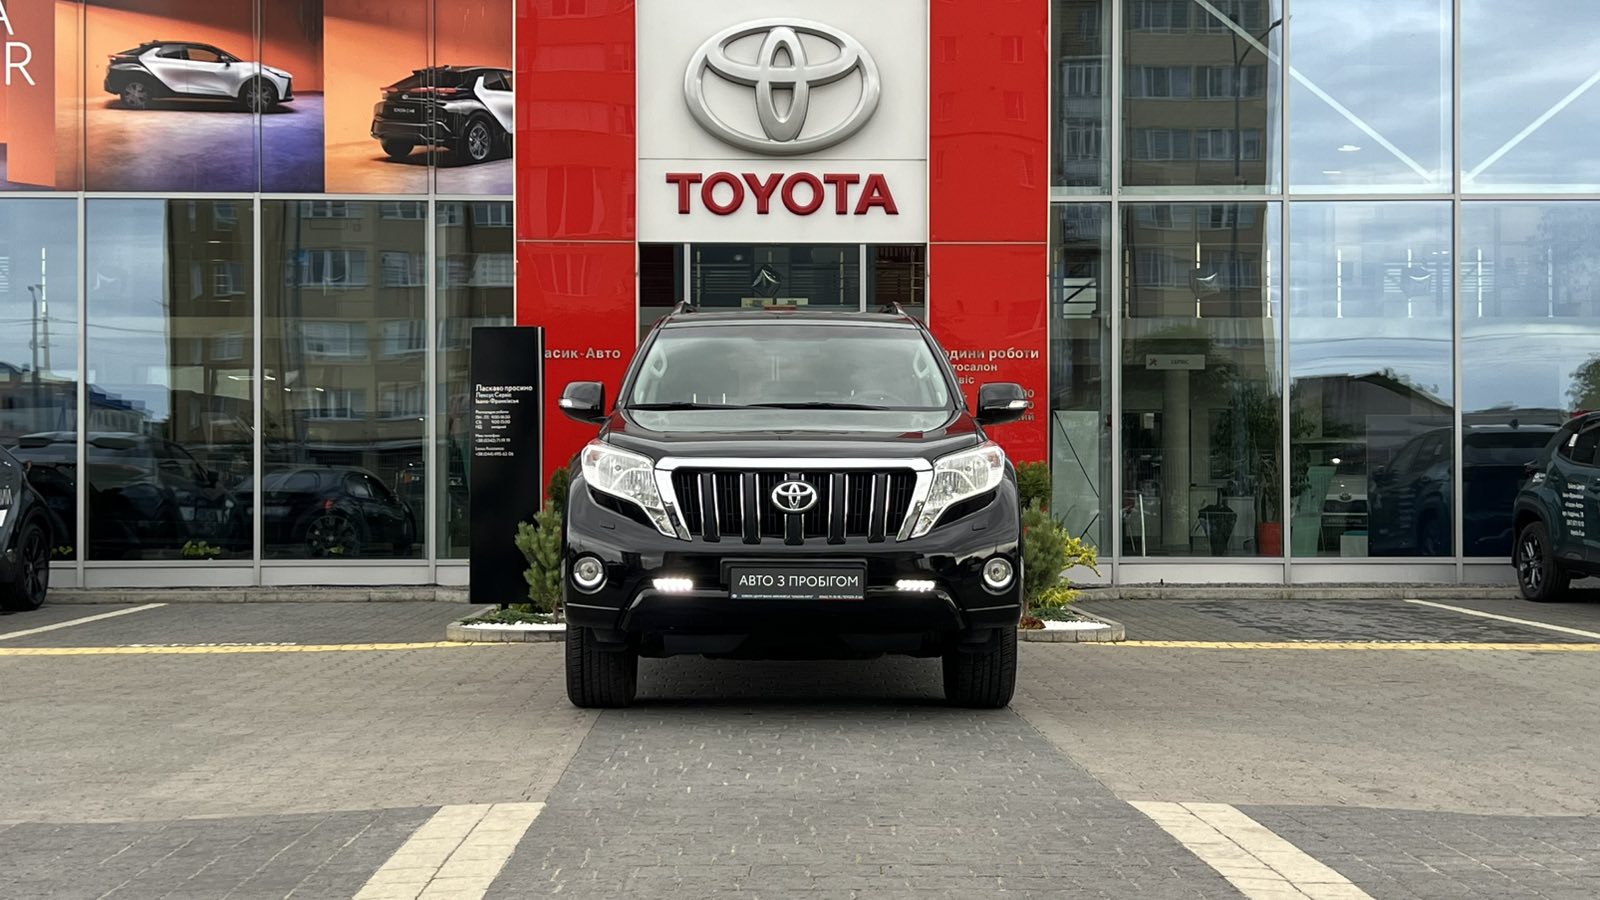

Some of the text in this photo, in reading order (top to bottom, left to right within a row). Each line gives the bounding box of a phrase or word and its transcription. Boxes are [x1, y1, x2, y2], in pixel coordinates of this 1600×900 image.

[666, 172, 899, 216] TOYOTA
[544, 347, 621, 359] асик-Авто
[944, 347, 1039, 361] одини роботи
[475, 384, 504, 392] Ласкаво
[739, 575, 859, 587] АВТО З ПРОБІГОМ
